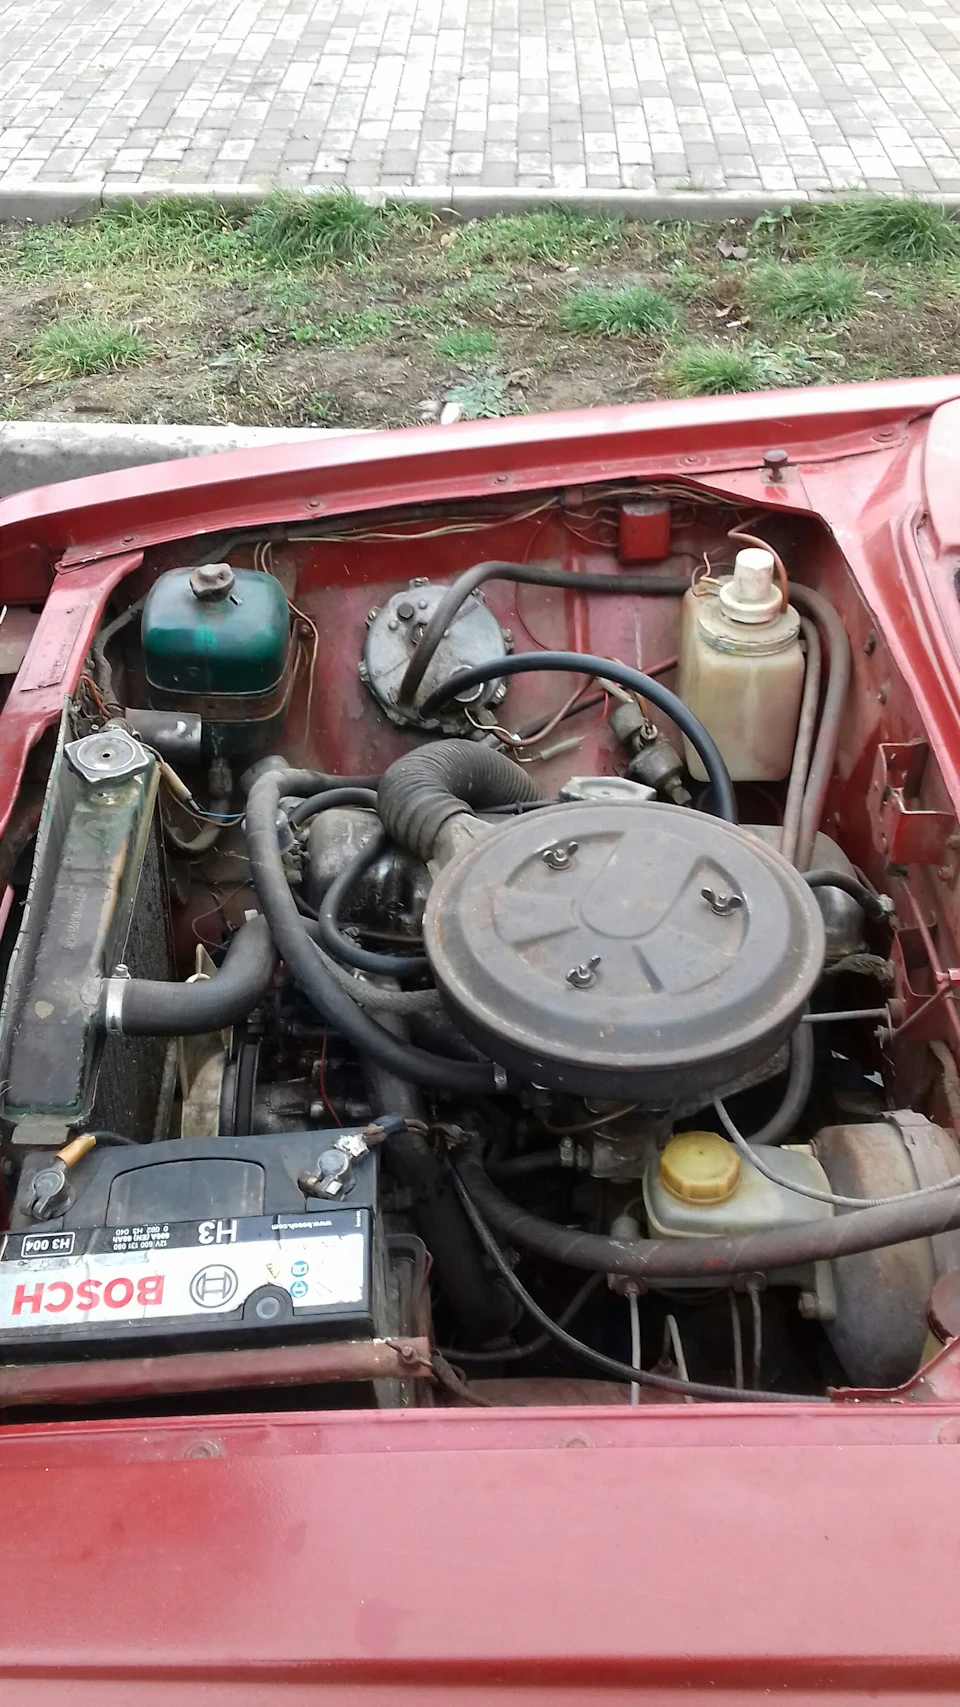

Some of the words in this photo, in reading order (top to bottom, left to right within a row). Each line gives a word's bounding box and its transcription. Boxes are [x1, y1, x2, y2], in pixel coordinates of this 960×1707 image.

[115, 1228, 130, 1236] 040
[198, 1219, 238, 1244] H3
[26, 1240, 49, 1252] 004
[52, 1237, 70, 1250] H3
[154, 1240, 168, 1248] 12V
[12, 1275, 165, 1315] BOSCH
